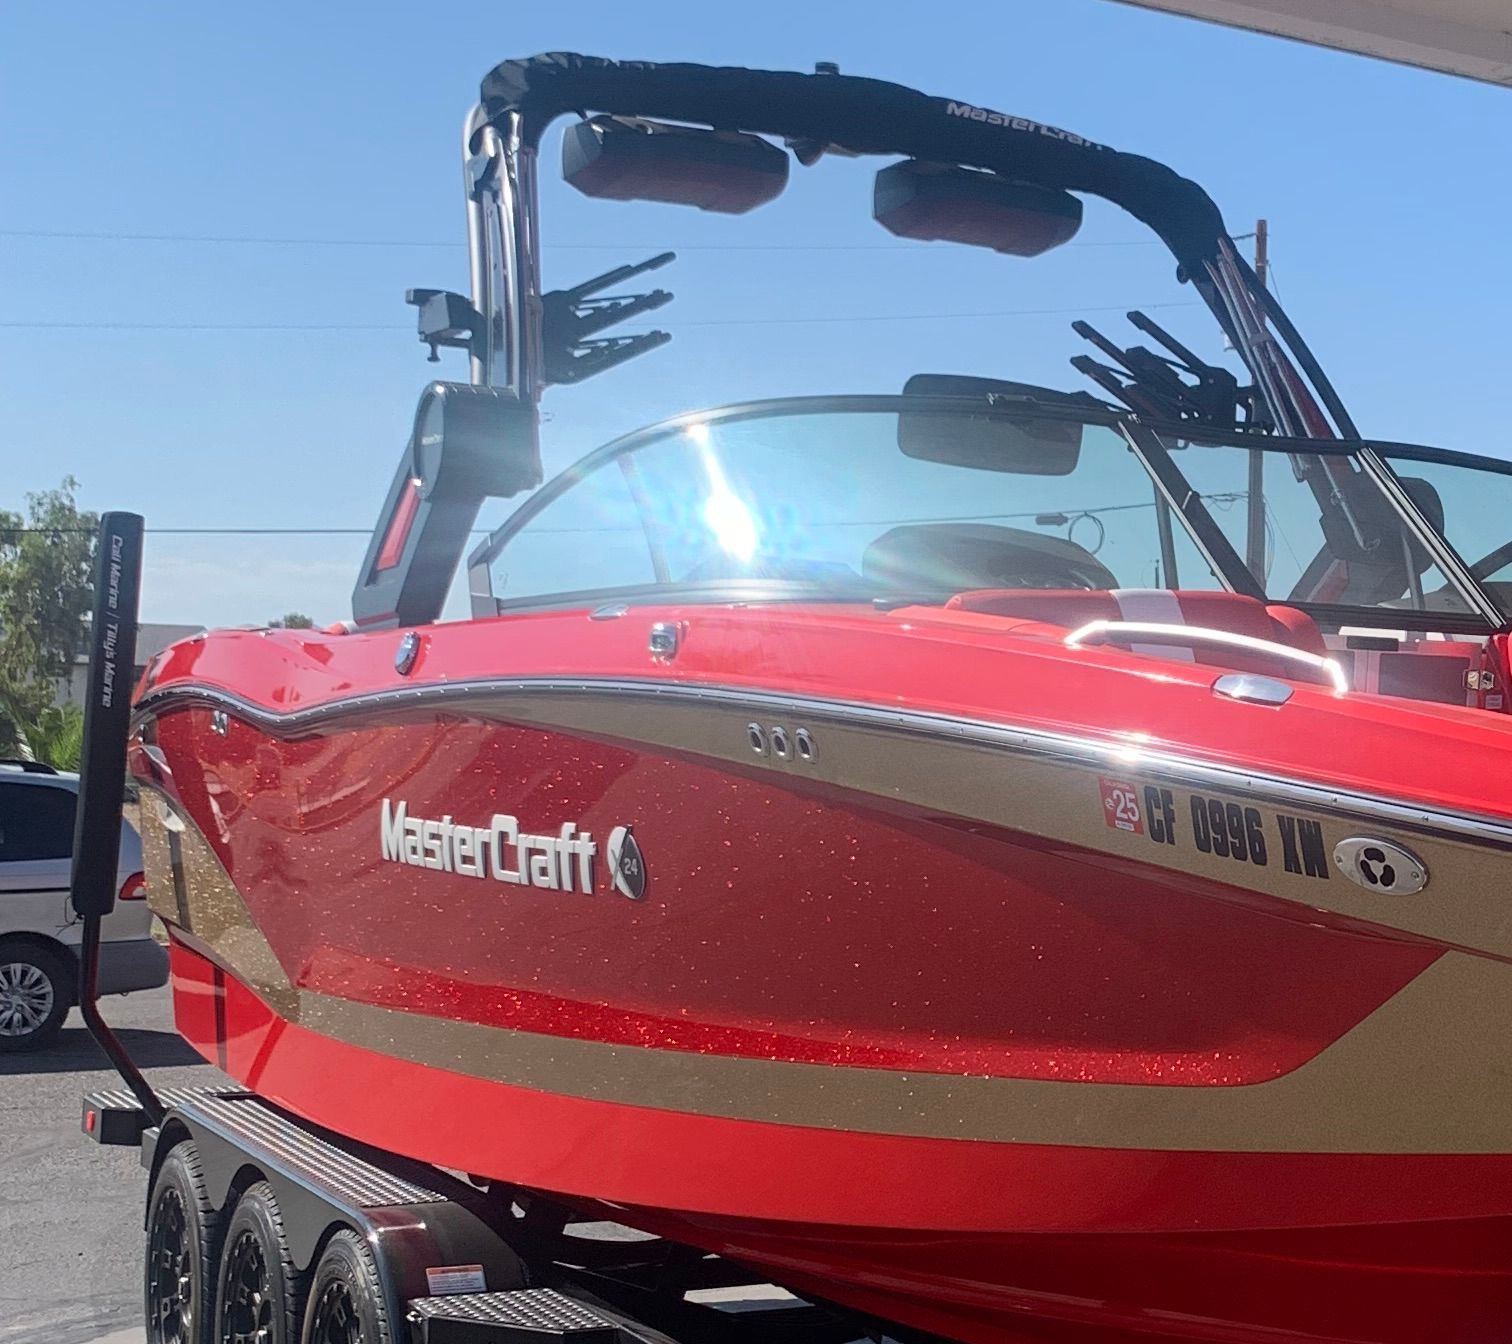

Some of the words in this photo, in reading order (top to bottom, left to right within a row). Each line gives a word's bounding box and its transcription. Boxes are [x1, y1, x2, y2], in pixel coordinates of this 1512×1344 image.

[947, 102, 1102, 151] MasterCra
[108, 562, 121, 609] Marine
[102, 661, 116, 708] Marine
[1112, 789, 1139, 822] 25
[1144, 786, 1176, 845] CF
[1190, 795, 1268, 867] 0996
[381, 798, 597, 895] MasterCraft
